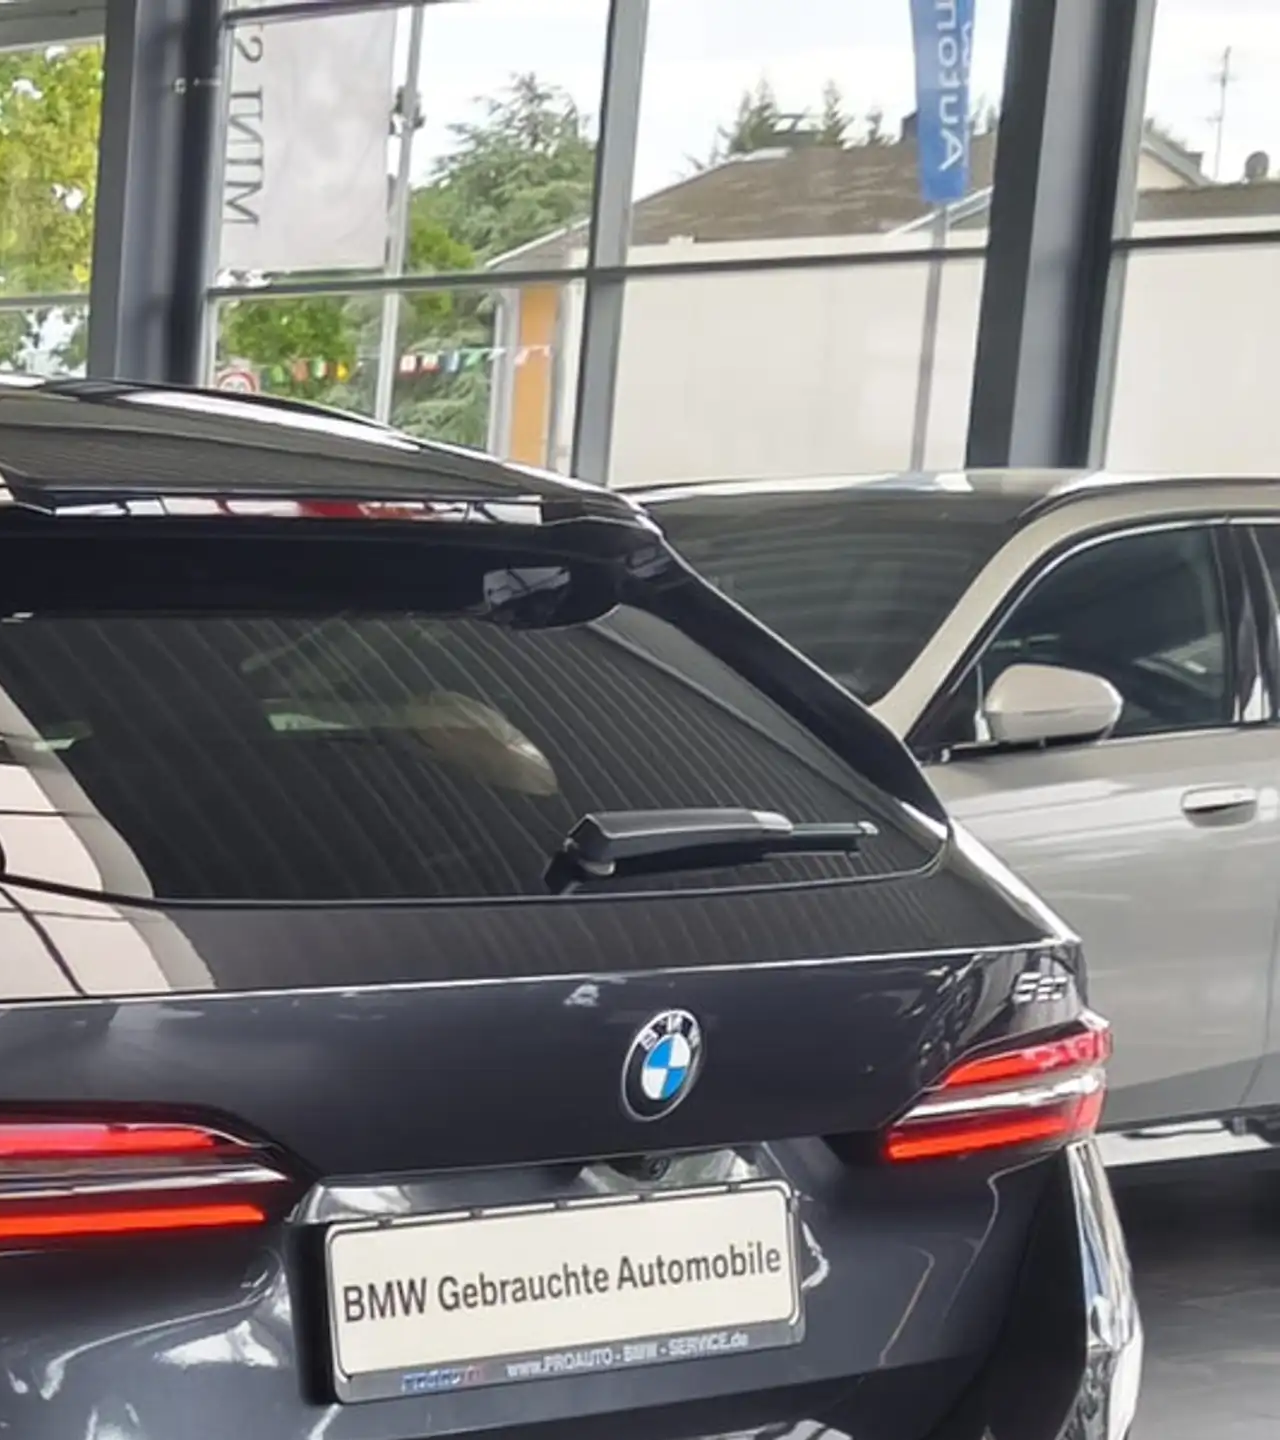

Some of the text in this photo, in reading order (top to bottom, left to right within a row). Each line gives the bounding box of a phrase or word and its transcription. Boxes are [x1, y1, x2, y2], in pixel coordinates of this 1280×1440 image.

[343, 1240, 781, 1323] BMW Gebrauchte Automobile
